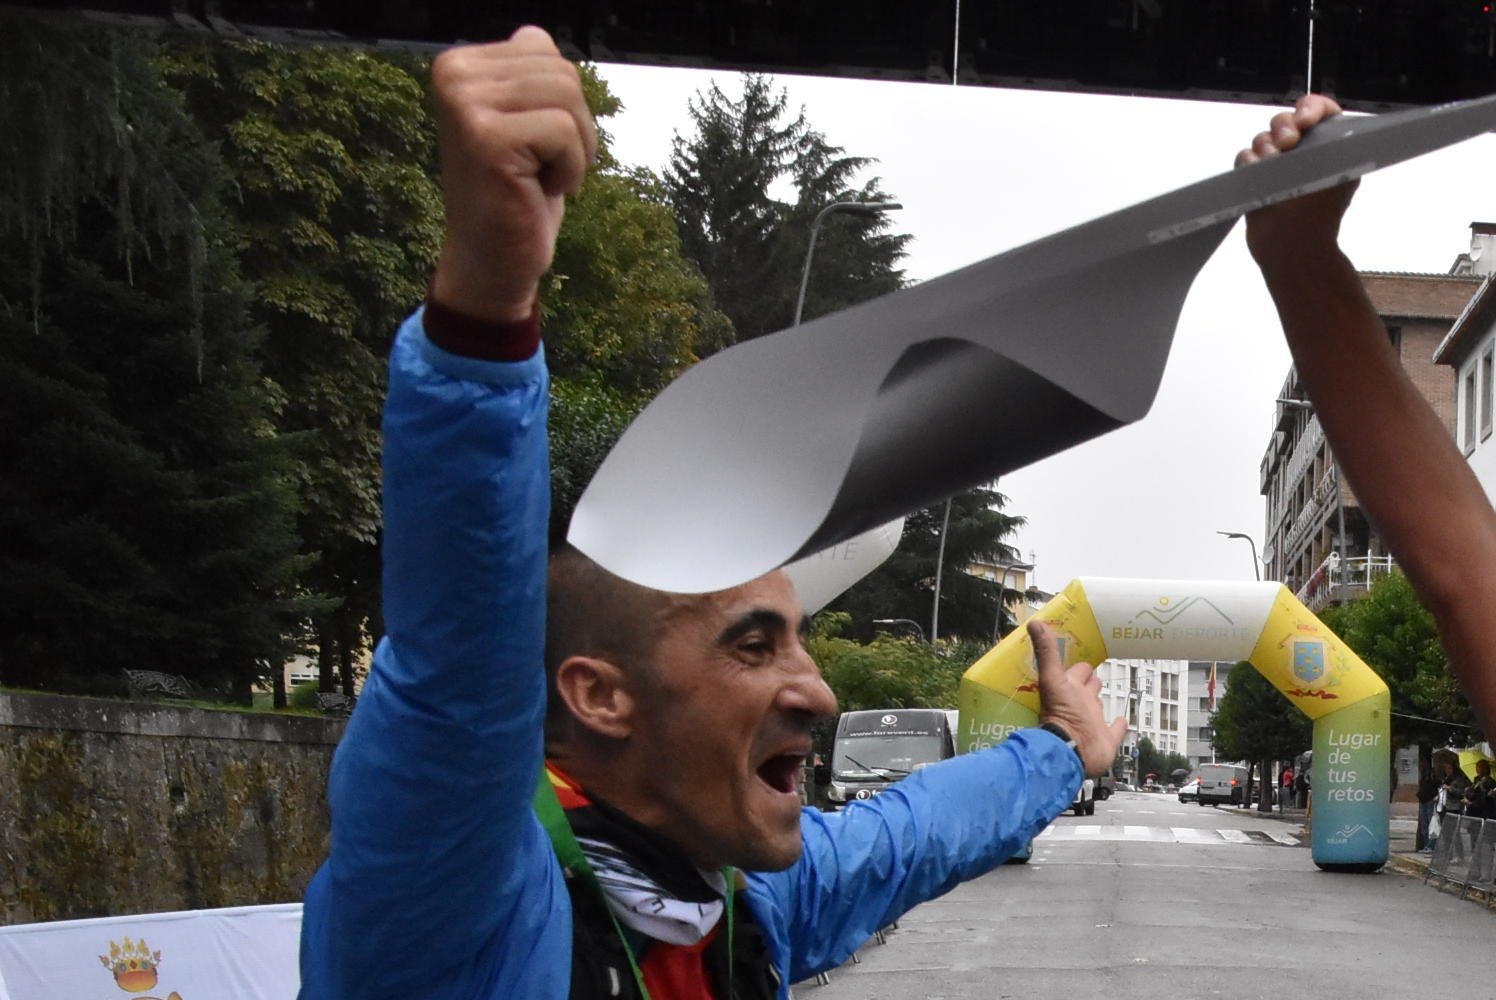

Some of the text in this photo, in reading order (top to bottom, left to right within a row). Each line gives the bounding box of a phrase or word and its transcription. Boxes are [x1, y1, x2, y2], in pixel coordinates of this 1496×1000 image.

[969, 718, 1025, 740] Luga
[1328, 729, 1381, 749] Lugar
[1328, 748, 1351, 764] de
[1328, 768, 1357, 783] tus
[1327, 786, 1375, 801] retos
